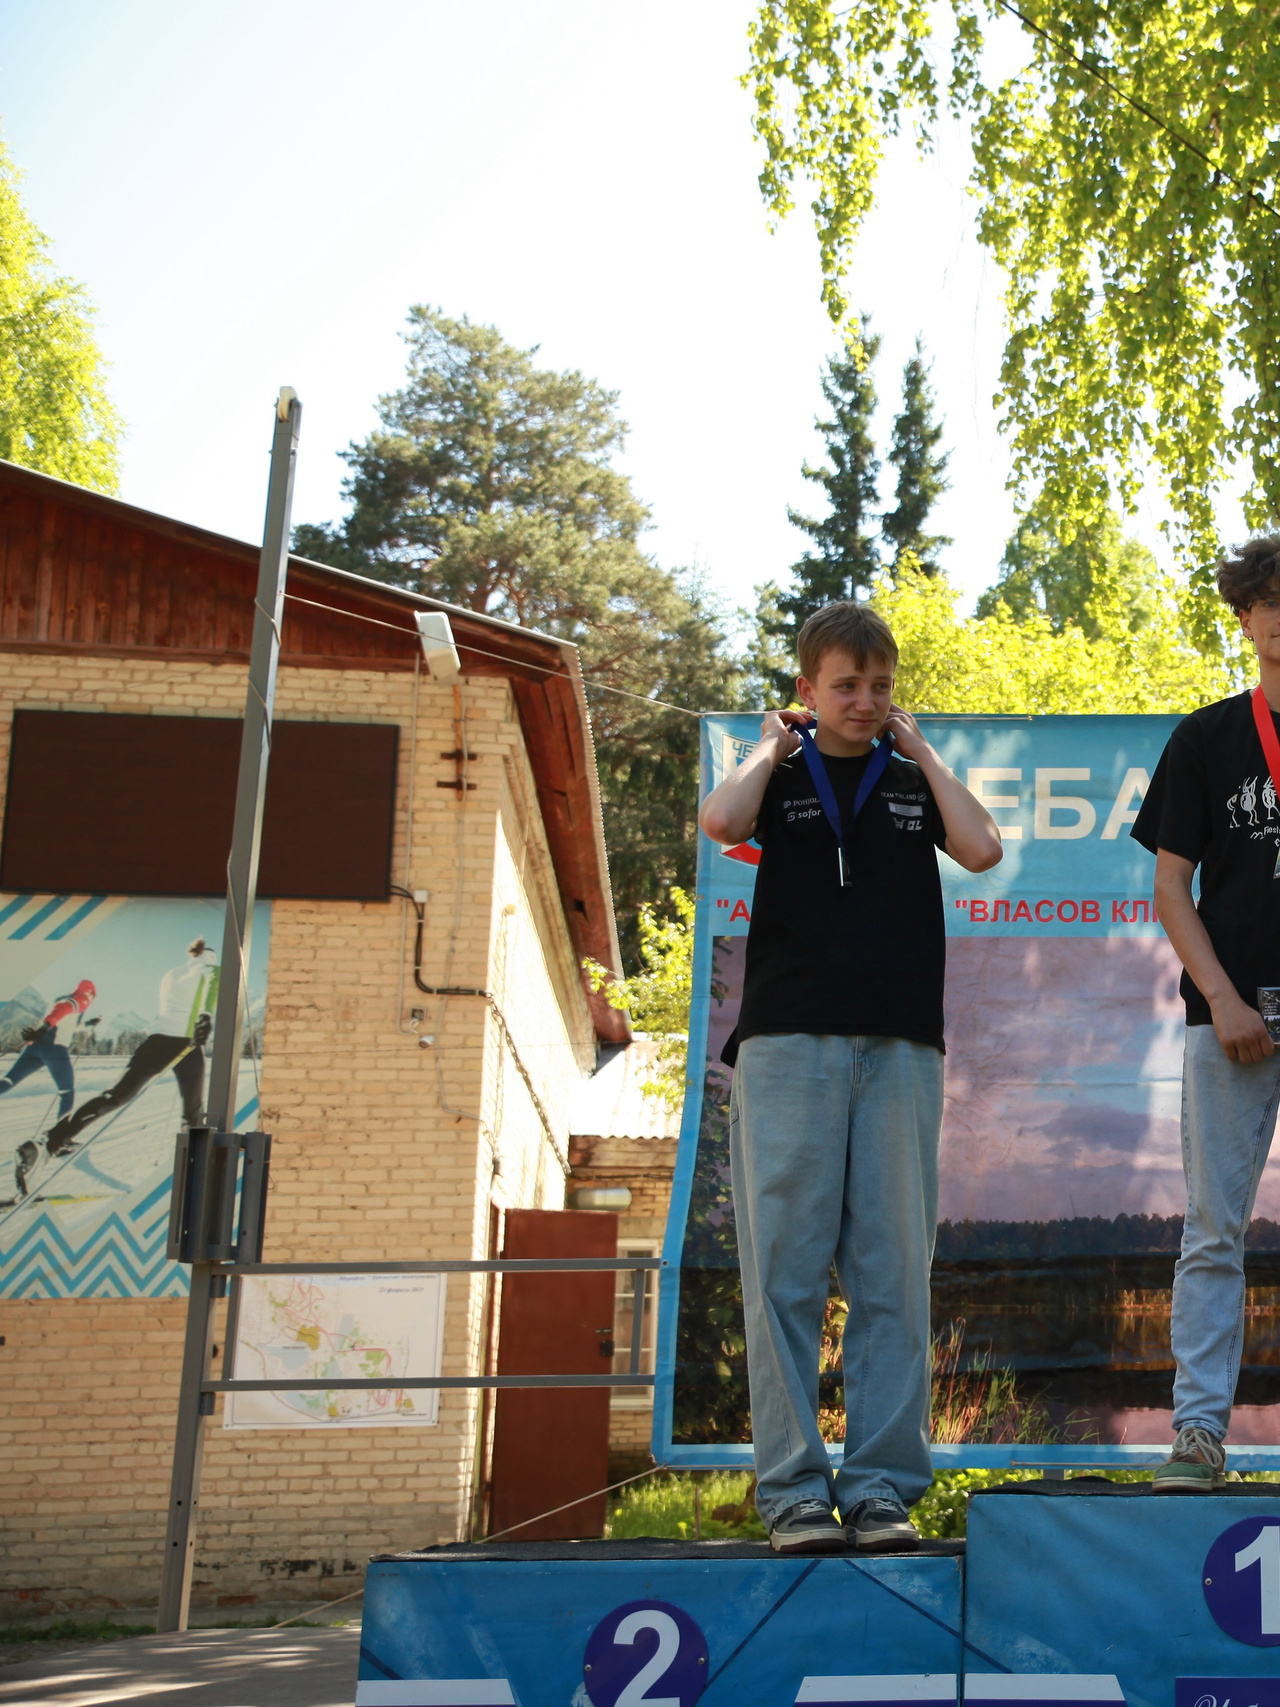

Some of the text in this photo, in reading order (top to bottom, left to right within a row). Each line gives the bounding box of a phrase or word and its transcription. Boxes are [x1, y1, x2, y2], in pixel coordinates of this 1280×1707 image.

[793, 798, 820, 807] POHJOL
[946, 767, 1151, 840] ЕБА
[955, 899, 1101, 923] "ВЛАСОВ
[612, 1608, 681, 1707] 2
